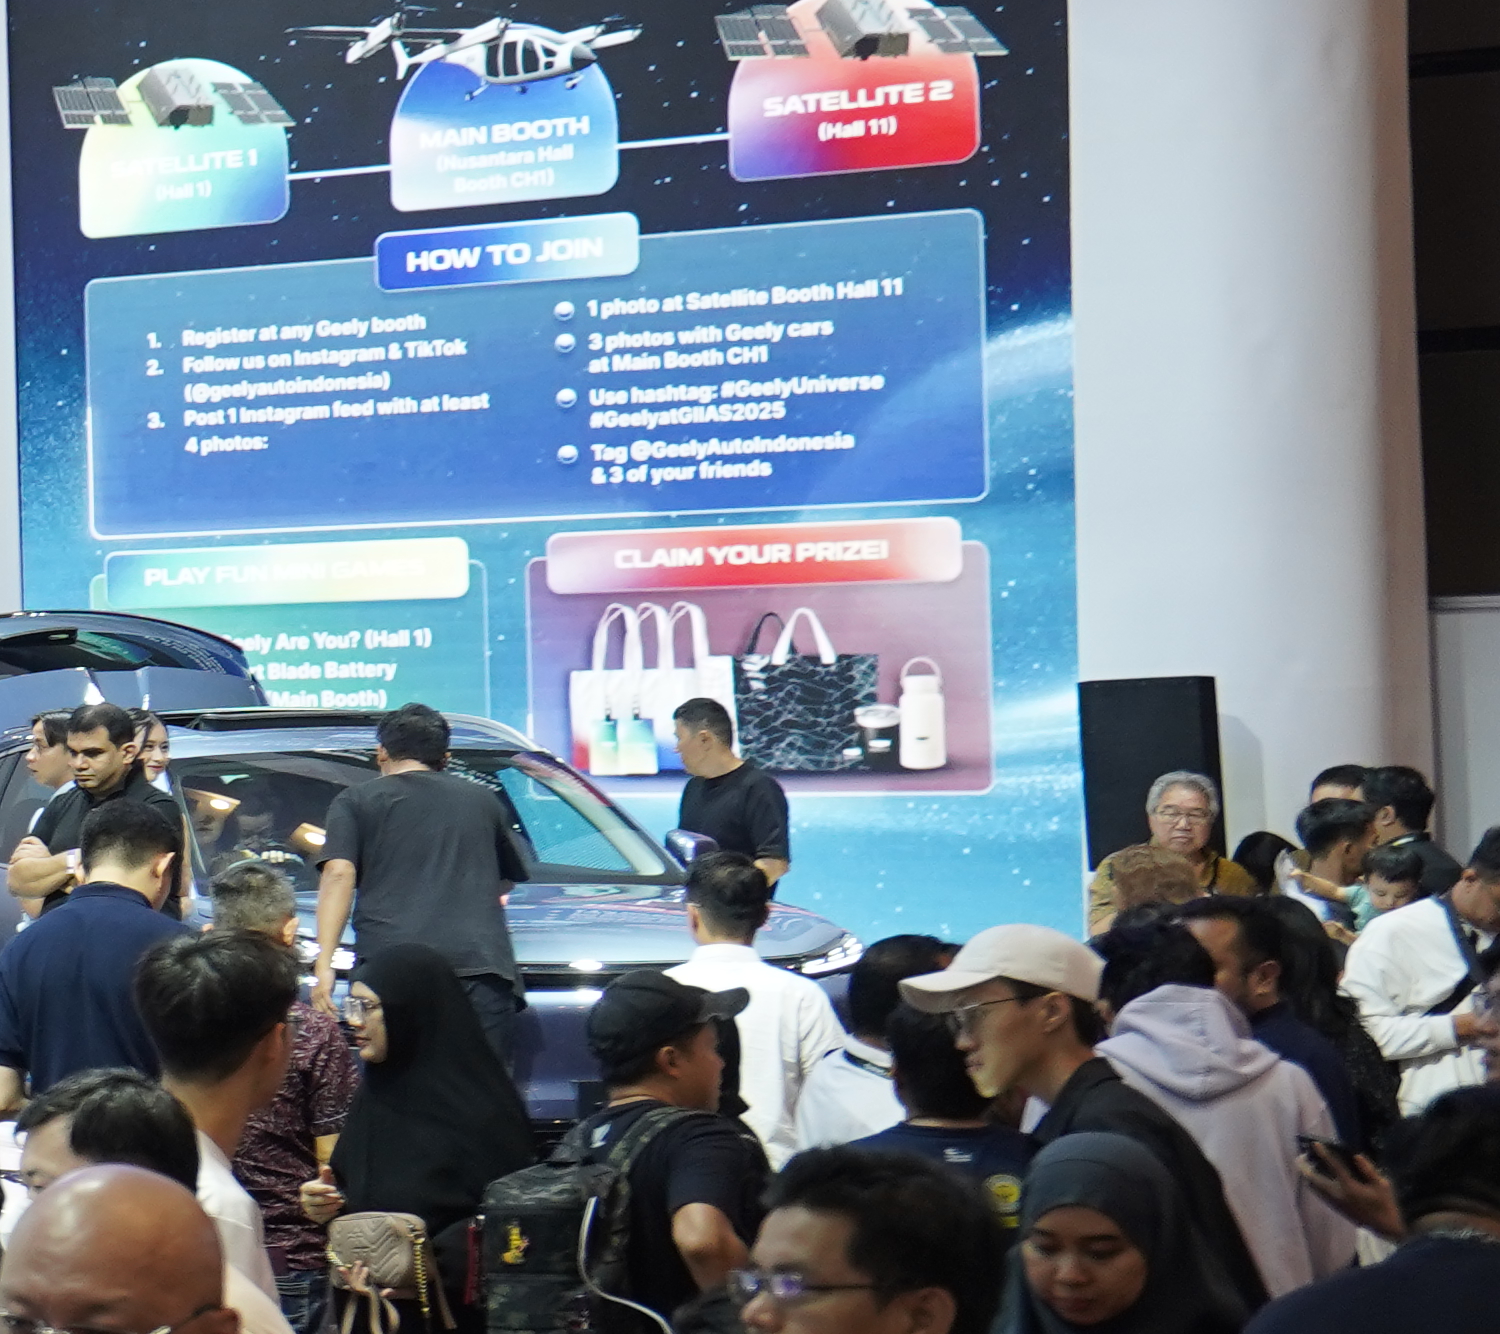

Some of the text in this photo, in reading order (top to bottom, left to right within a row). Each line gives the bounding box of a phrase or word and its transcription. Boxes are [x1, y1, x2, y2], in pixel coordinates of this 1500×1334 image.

[763, 78, 955, 117] SATELLITE 2
[419, 115, 591, 150] MAIN BOOTH
[817, 115, 897, 142] (Hall 11)
[247, 148, 258, 167] 1
[537, 143, 575, 164] Hall
[453, 167, 556, 194] Booth CH1)
[405, 235, 605, 275] HOW TO JOIN
[587, 277, 904, 320] 1 photo at Satellite Booth Hall 11
[146, 332, 162, 349] 1.
[182, 313, 427, 348] Register at any Geely booth
[588, 319, 834, 353] 3 photos with Geely cars
[146, 358, 164, 377] 2.
[182, 337, 468, 374] Follow us on Instagram & TikTok
[588, 344, 770, 373] at Main Booth CH1
[184, 369, 391, 405] (@geelyautoindonesia)
[589, 373, 886, 407] Use hashtag: #GeelyUniverse
[146, 412, 166, 430] 3.
[183, 391, 491, 427] Post 1 Instagram feed with at least
[589, 400, 787, 431] #GeelyatGIIAS2025
[184, 434, 269, 456] 4 photos:
[590, 430, 855, 464] Tag @GeelyAutoIndonesia
[591, 458, 773, 486] & 3 of your friends
[614, 539, 890, 569] CLAIM YOUR PRIZE!
[143, 567, 212, 587] PLAY
[215, 564, 272, 584] FUN
[275, 632, 310, 651] Are
[312, 630, 360, 651] You?
[364, 628, 411, 650] (Hall
[412, 627, 432, 648] 1)
[267, 662, 322, 680] Blade
[324, 661, 397, 682] Battery
[320, 689, 387, 709] Booth)
